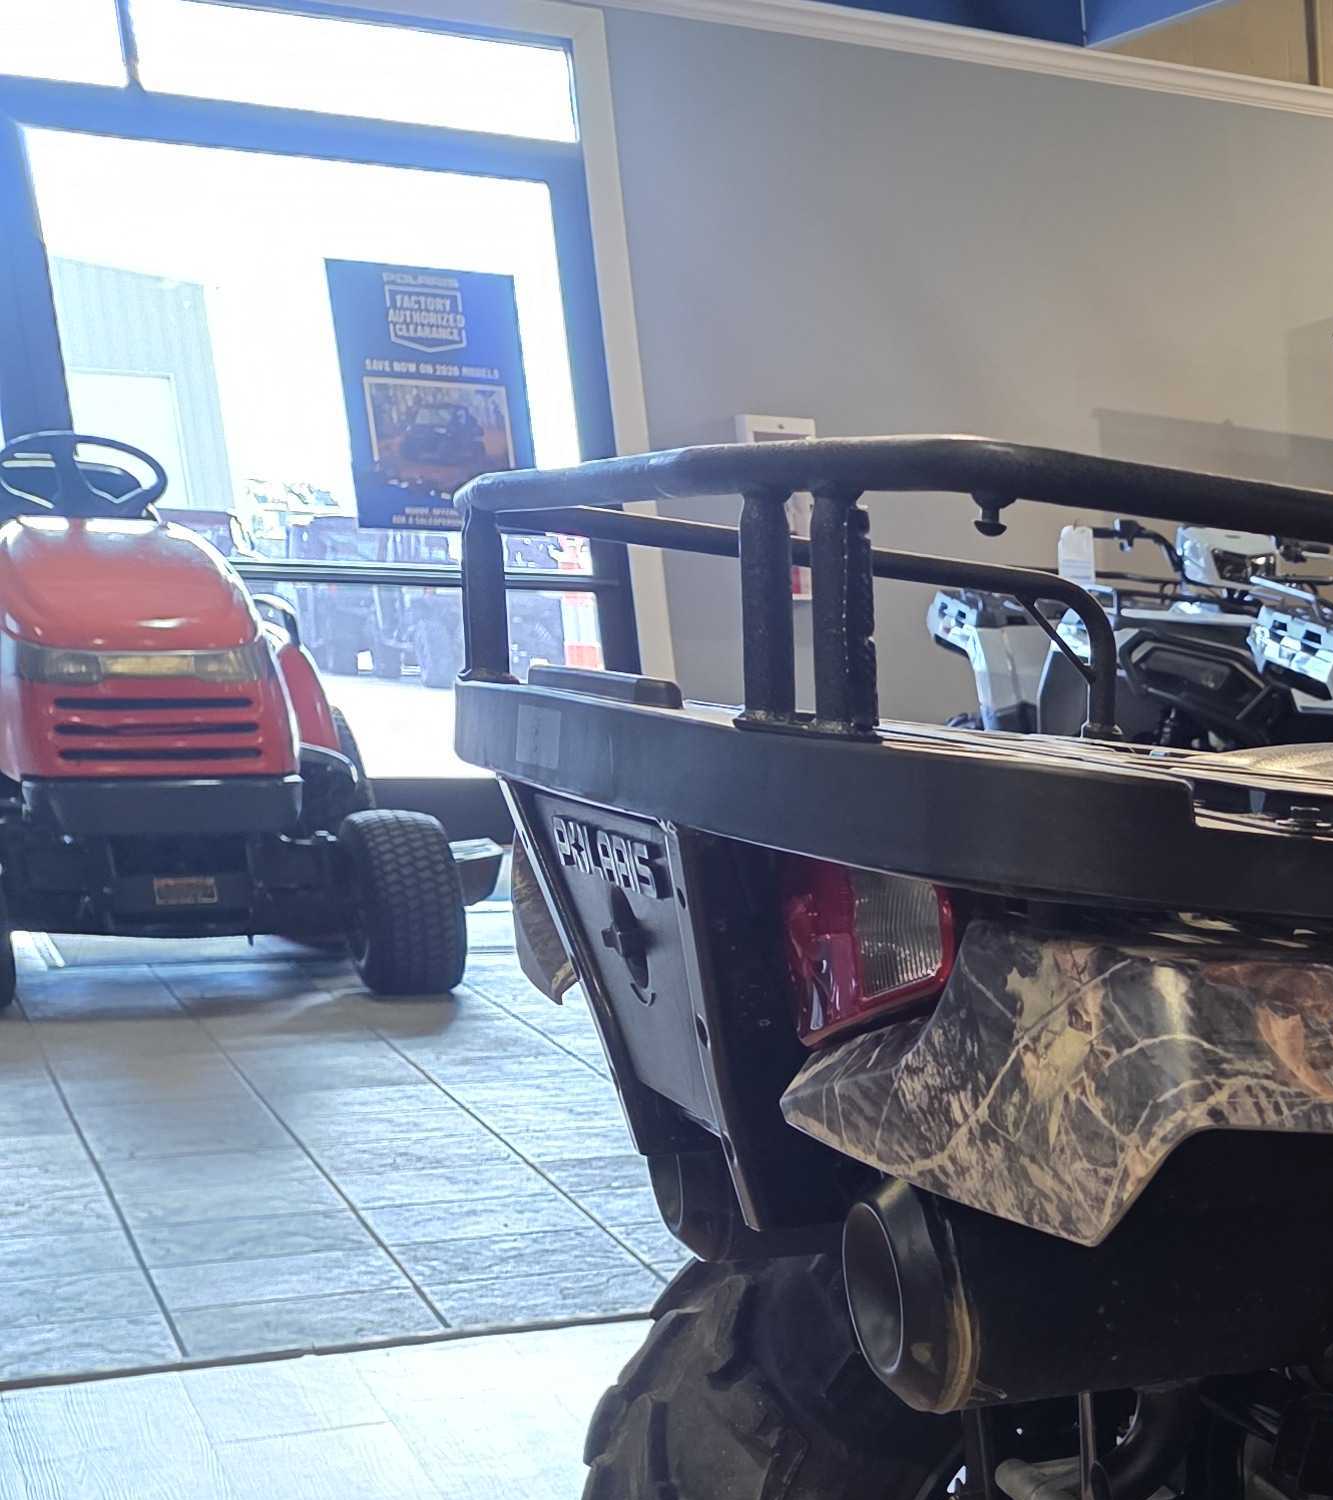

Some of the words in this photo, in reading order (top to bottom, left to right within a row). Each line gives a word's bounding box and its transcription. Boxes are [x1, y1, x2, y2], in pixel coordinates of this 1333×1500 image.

[395, 294, 451, 312] FACTORY
[388, 308, 465, 328] AUTHORIZED
[394, 323, 460, 342] CLEARANCE
[392, 360, 417, 373] NOW
[551, 815, 659, 899] POLARIS
